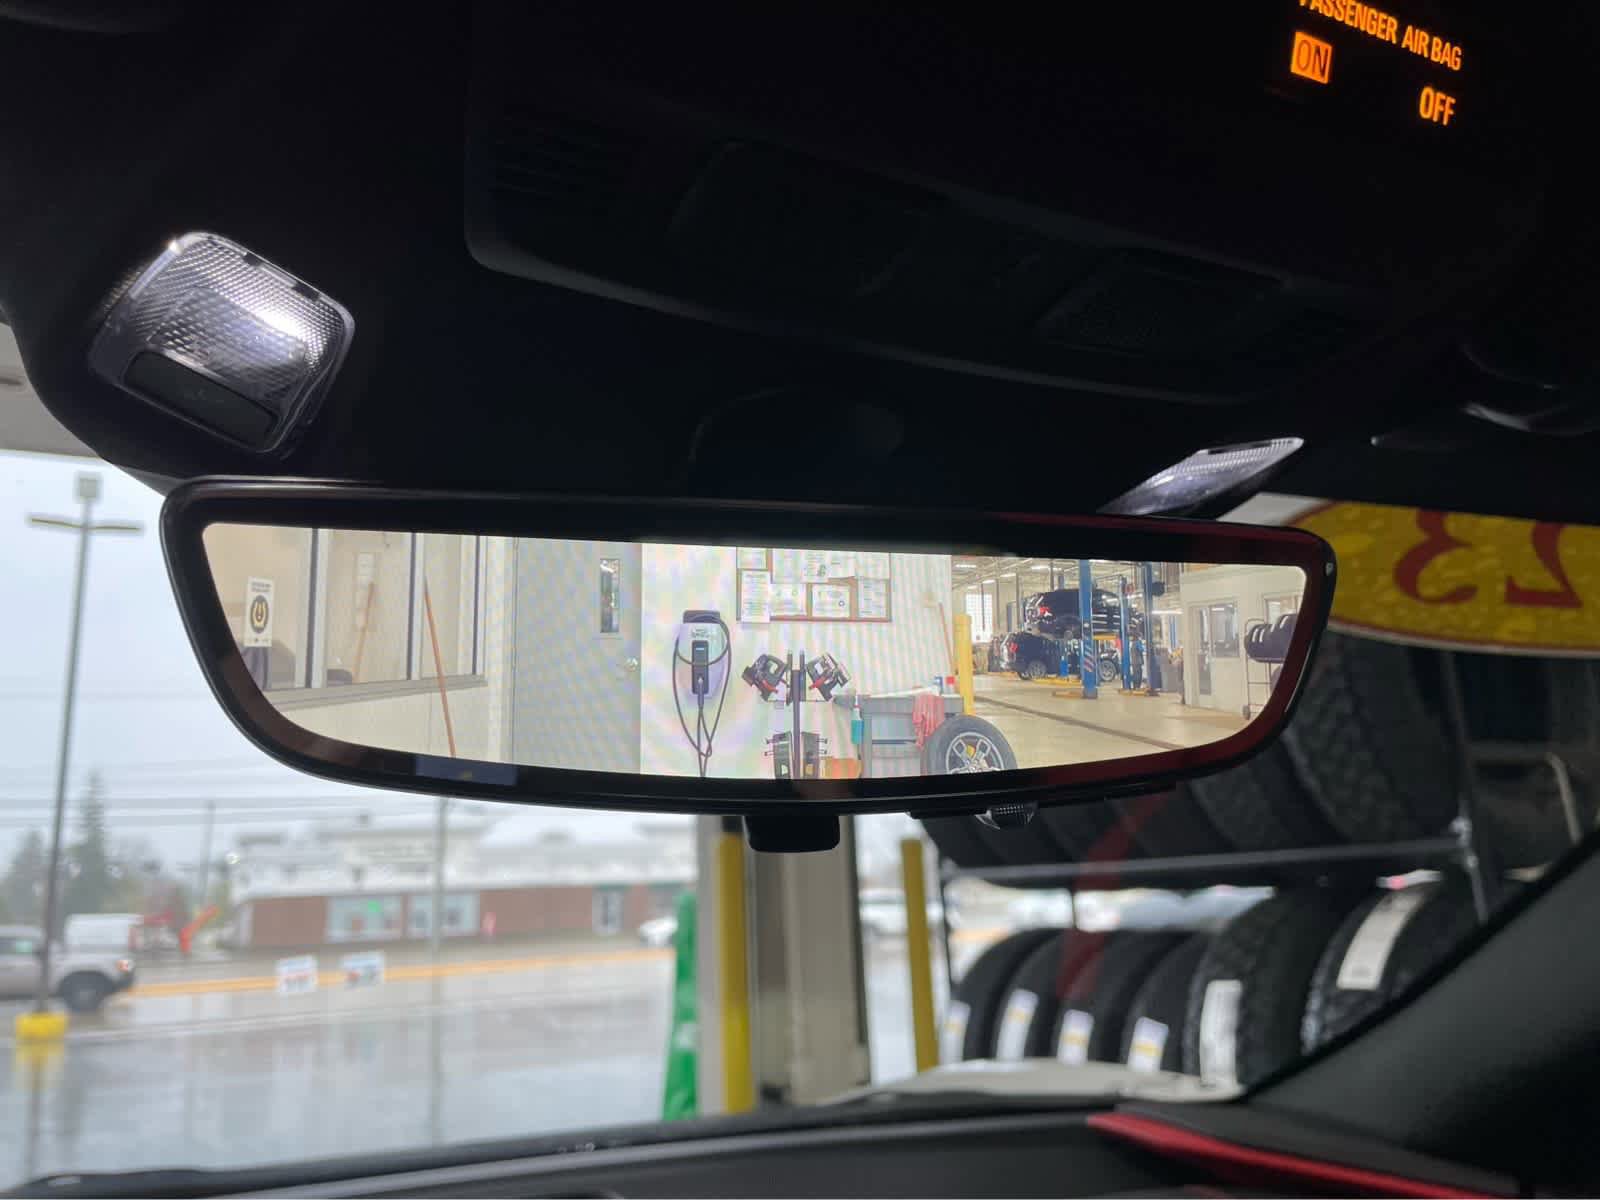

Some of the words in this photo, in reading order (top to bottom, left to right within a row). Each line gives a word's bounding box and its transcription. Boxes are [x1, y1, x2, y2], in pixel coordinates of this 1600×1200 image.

[1299, 0, 1398, 44] ASSENGER
[1401, 25, 1430, 58] AIR
[1430, 37, 1461, 71] BAG
[1297, 39, 1330, 79] ON
[1419, 86, 1456, 126] OFF
